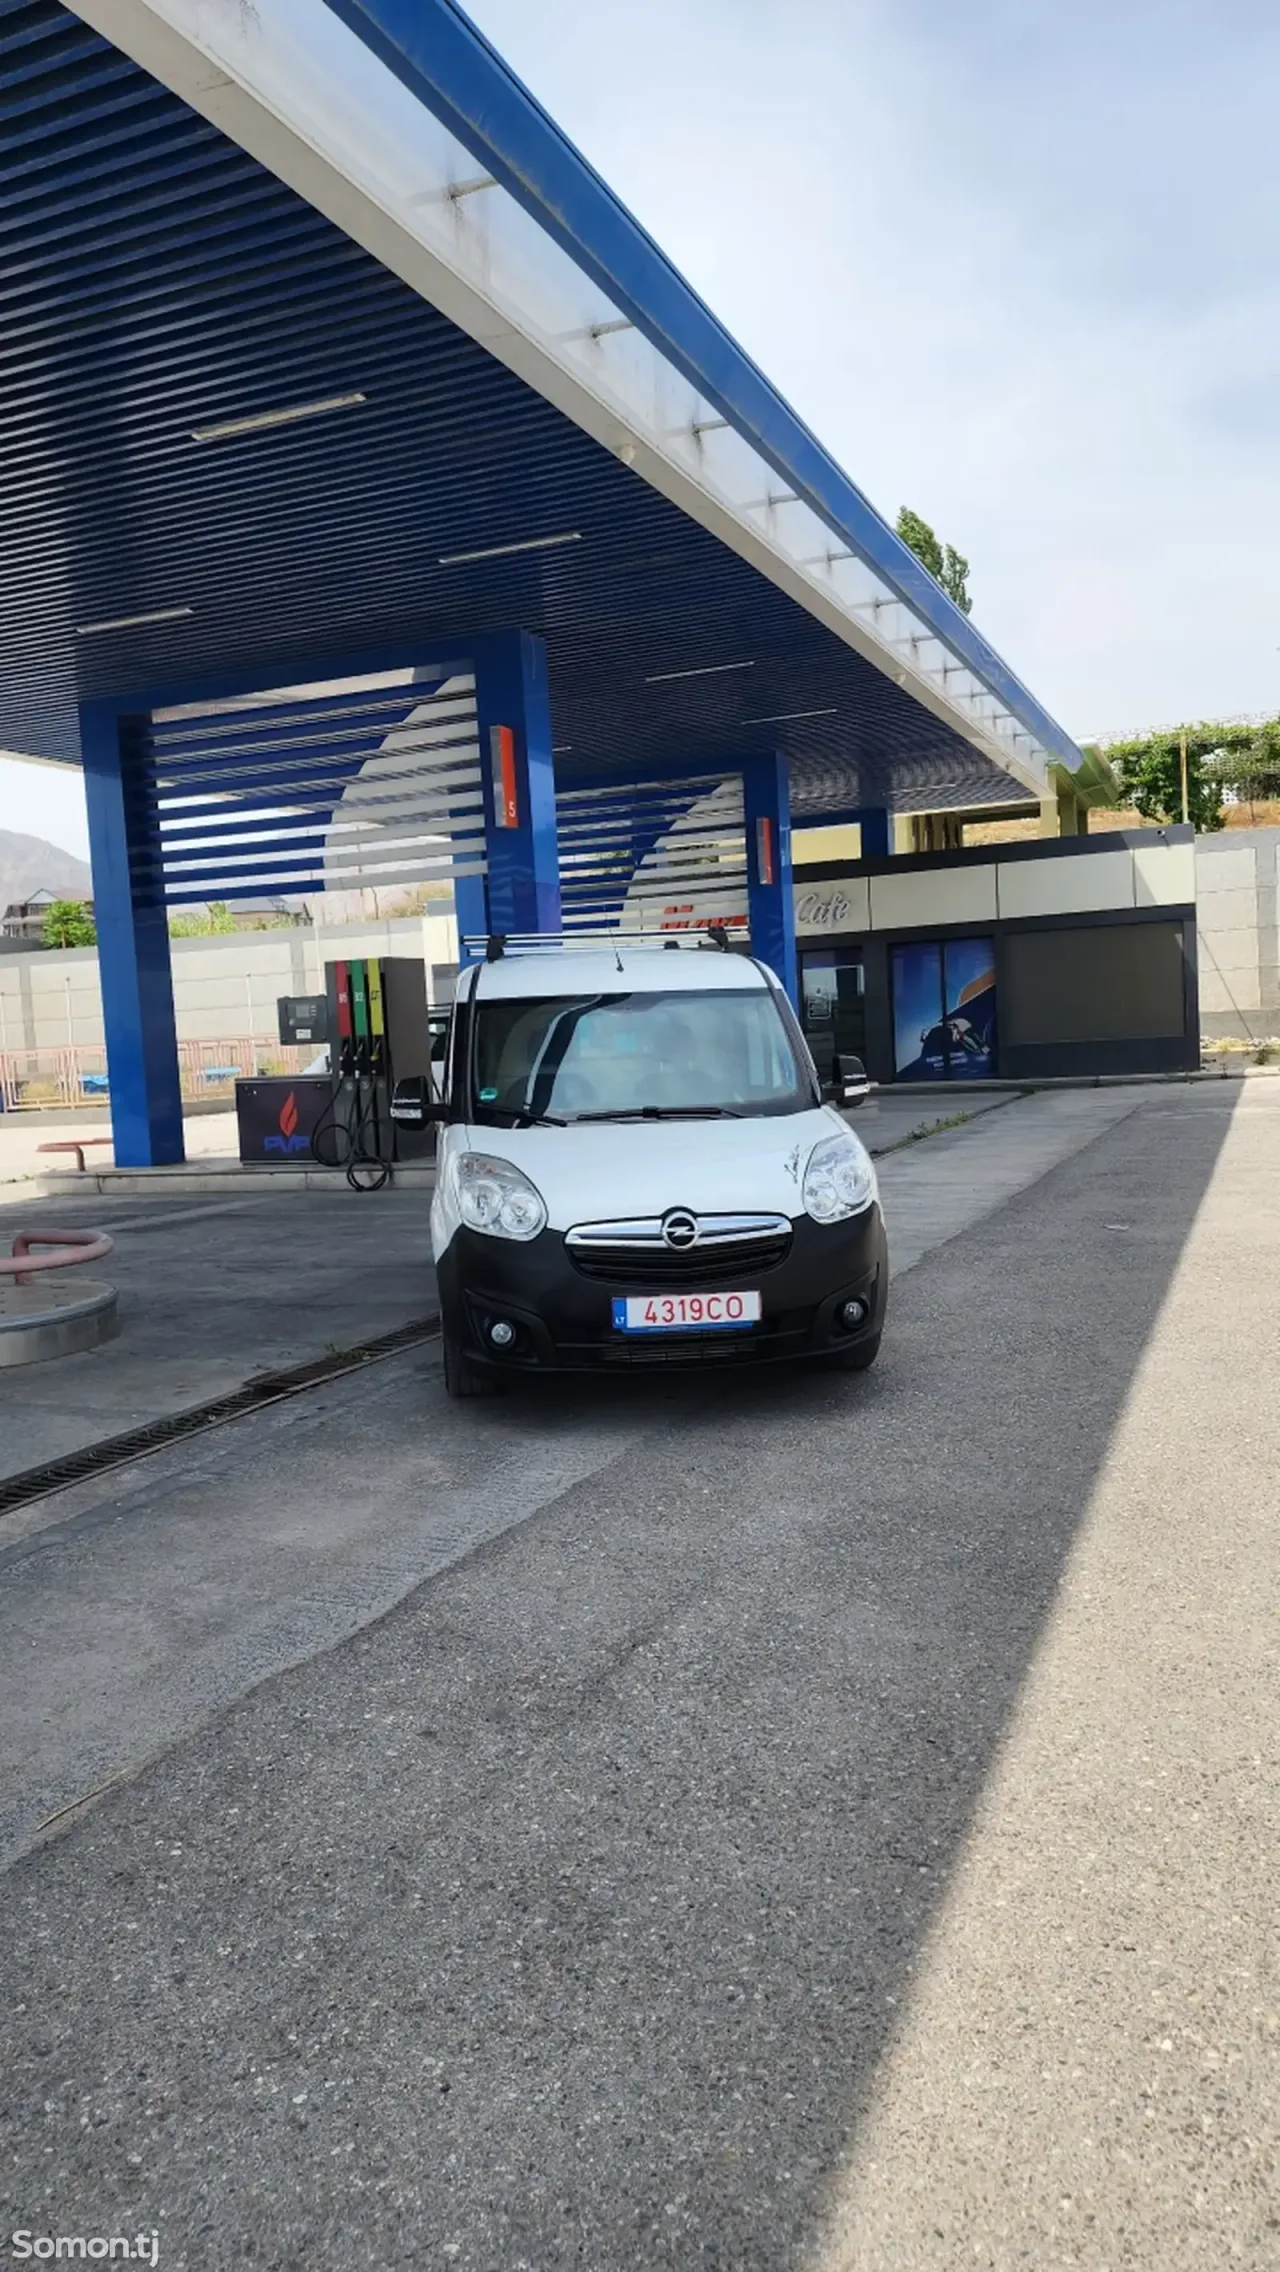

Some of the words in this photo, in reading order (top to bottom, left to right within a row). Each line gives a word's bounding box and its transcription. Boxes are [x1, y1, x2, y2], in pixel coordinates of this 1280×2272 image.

[263, 1134, 309, 1153] PVP
[644, 1295, 743, 1324] 4319CO
[615, 1316, 626, 1325] LT
